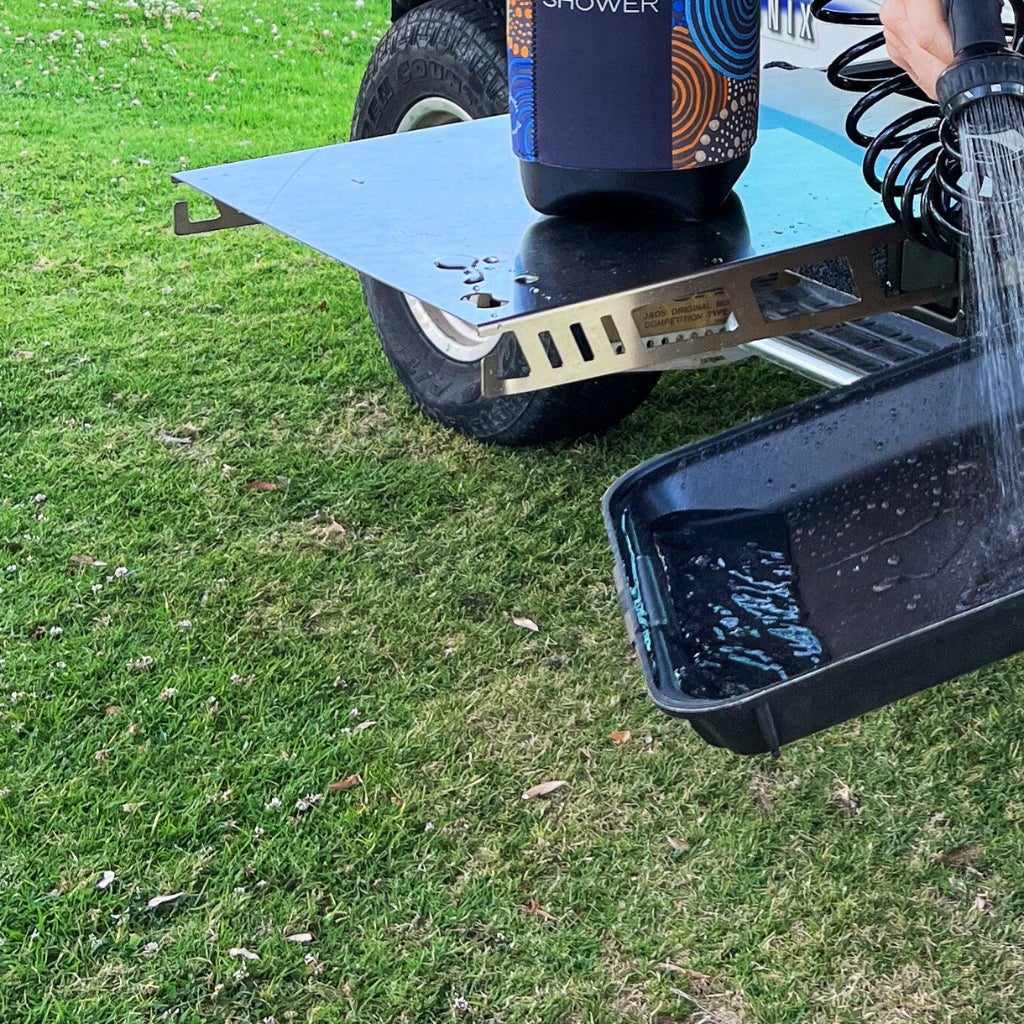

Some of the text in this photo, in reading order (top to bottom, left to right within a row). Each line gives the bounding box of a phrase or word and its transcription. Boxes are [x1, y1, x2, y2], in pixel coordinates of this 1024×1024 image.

[643, 313, 704, 329] COMPETITION
[707, 307, 728, 319] TYPE
[644, 309, 667, 321] JAOS
[671, 301, 711, 316] ORIGINAL
